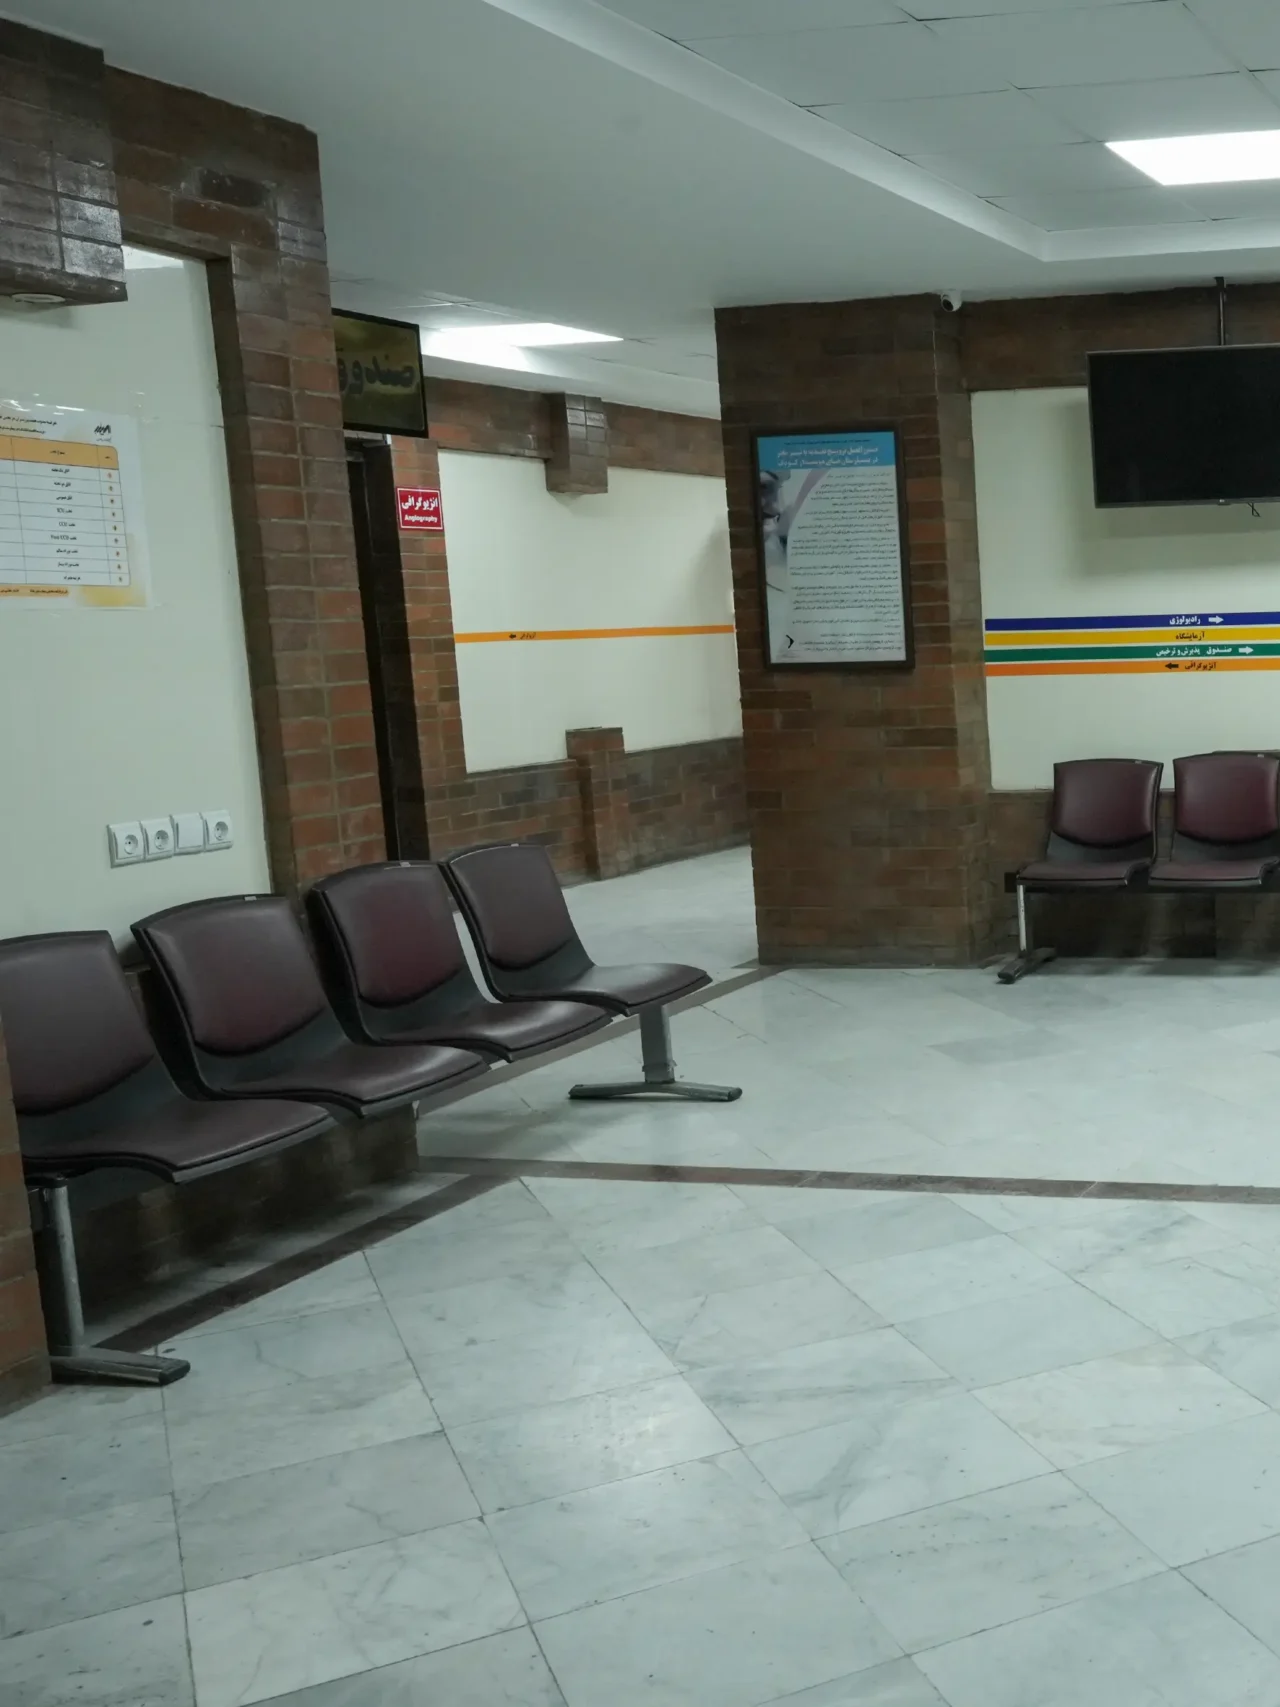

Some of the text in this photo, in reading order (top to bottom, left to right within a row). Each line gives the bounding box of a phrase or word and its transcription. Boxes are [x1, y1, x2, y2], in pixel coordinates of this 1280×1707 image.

[404, 514, 438, 523] Angiography
[1175, 630, 1205, 641] آزمایشگاه
[1155, 648, 1177, 657] ترخیص
[1181, 647, 1201, 656] پذیرش
[1206, 646, 1232, 655] صندوق
